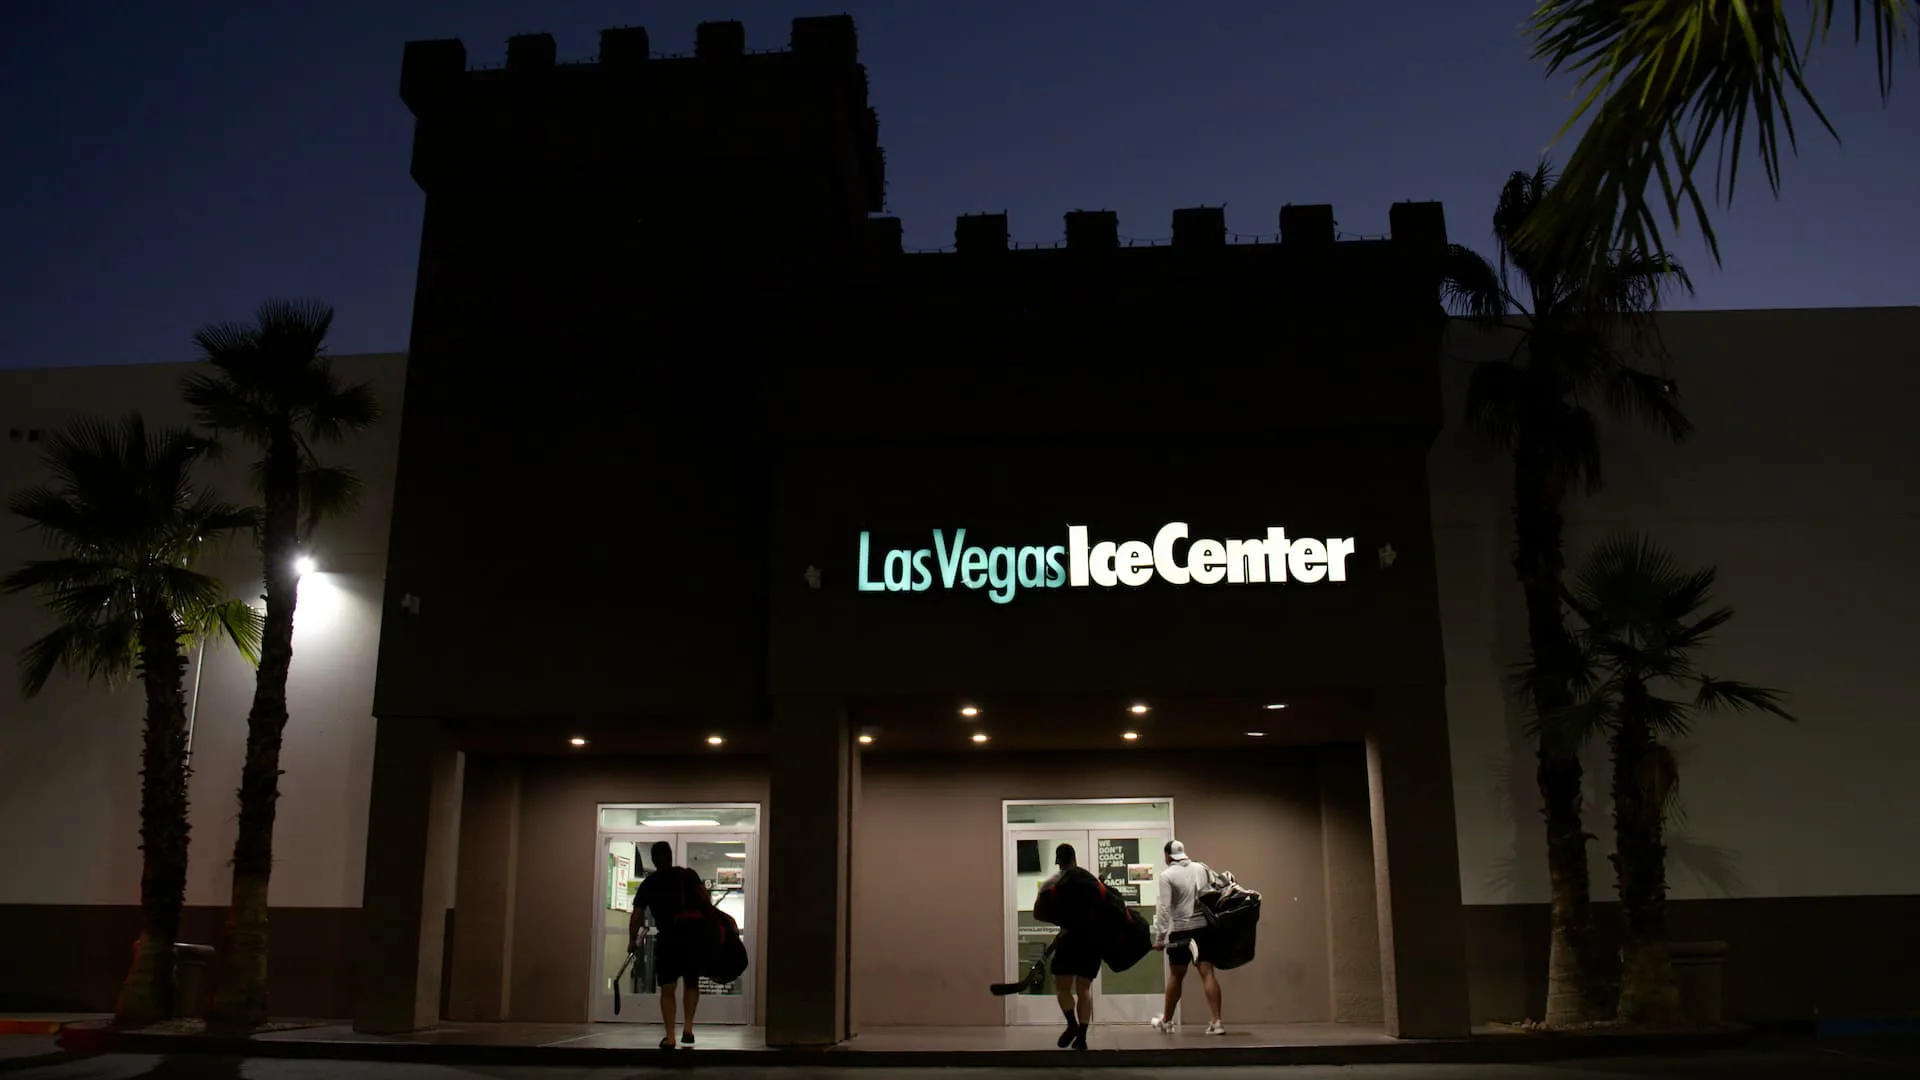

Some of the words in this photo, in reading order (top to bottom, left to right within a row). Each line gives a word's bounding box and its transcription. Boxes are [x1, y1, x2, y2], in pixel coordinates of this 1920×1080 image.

[1099, 846, 1122, 854] DON'T
[1099, 853, 1125, 861] COACH
[1103, 878, 1125, 886] OACH
